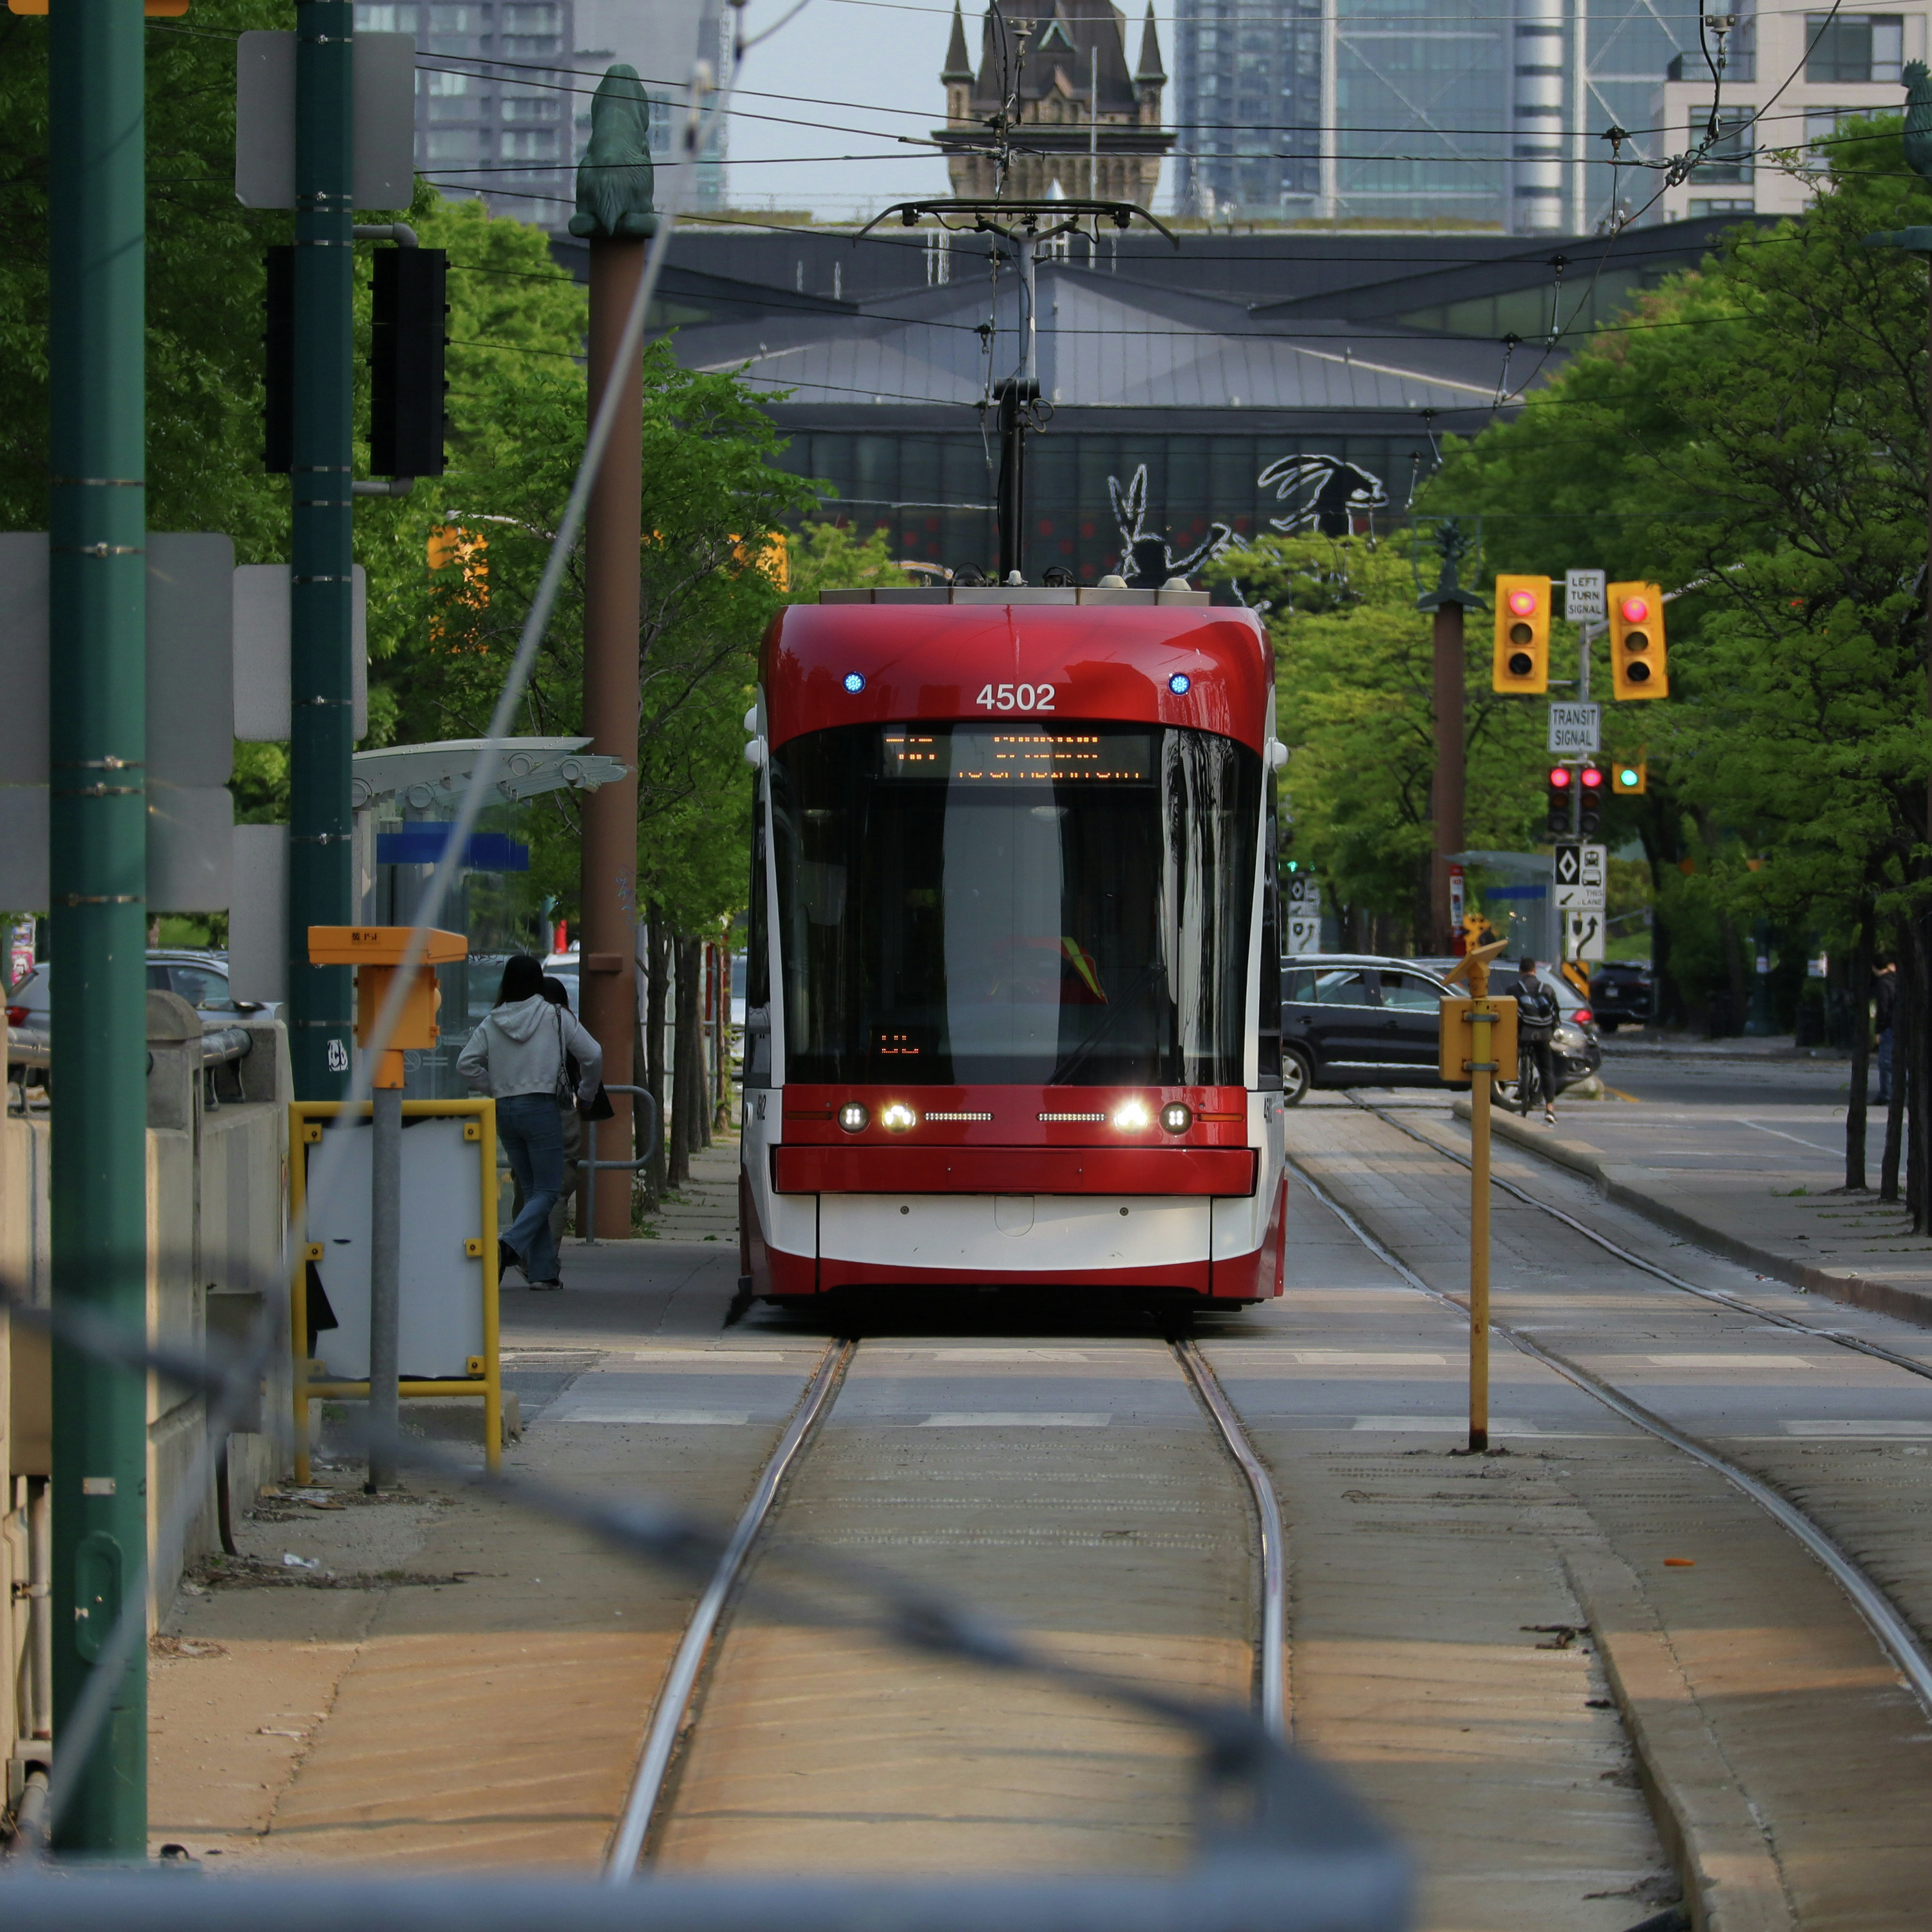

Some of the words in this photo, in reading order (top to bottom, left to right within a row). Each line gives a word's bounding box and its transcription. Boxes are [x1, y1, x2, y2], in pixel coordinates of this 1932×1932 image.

[1572, 577, 1598, 586] LEFT
[1571, 591, 1599, 600] TURN
[1568, 604, 1602, 614] SIGNAL
[976, 683, 1056, 710] 4502
[1553, 709, 1596, 725] TRANSIT
[1554, 729, 1593, 746] SIGNAL
